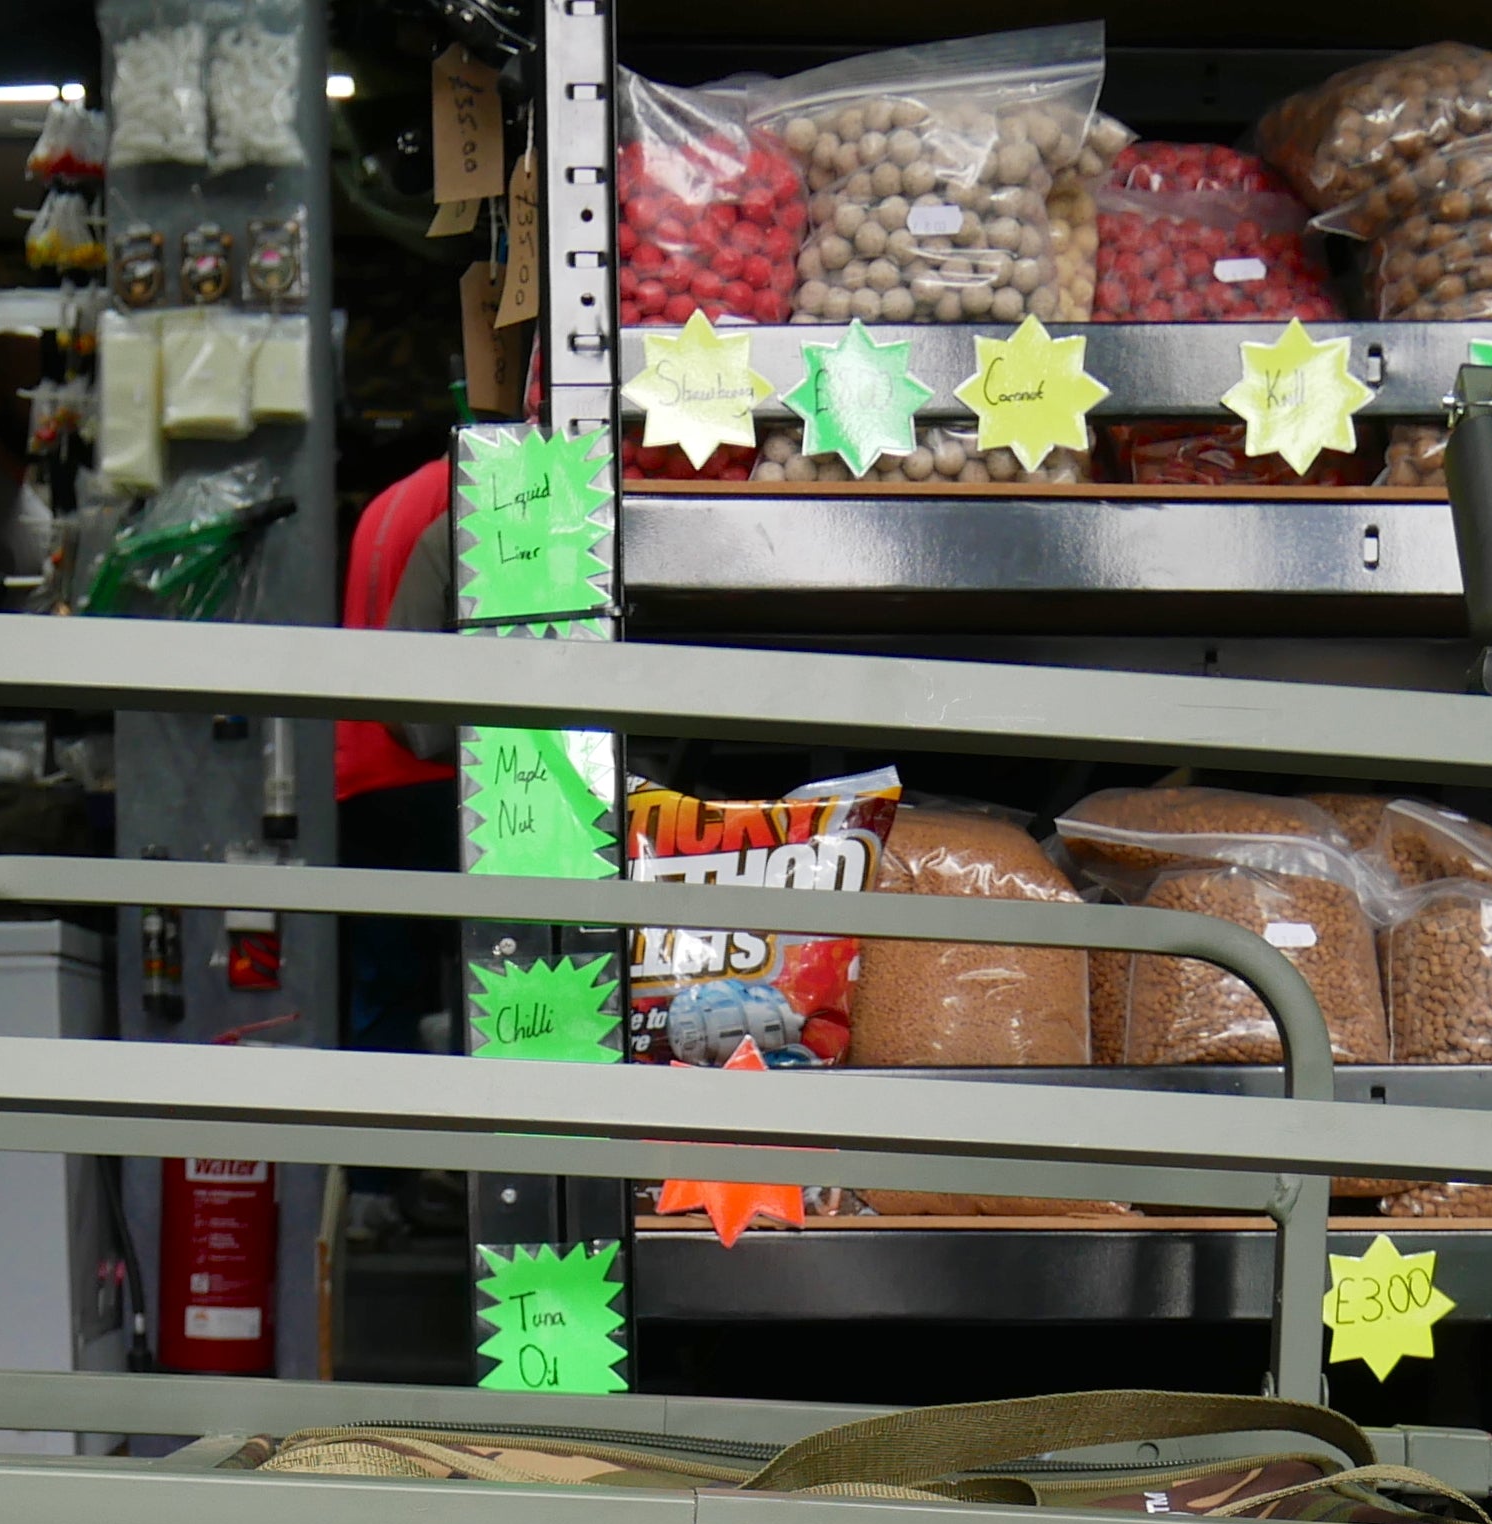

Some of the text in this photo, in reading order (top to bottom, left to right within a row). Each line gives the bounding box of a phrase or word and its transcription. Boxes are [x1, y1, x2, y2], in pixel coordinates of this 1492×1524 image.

[492, 472, 552, 519] Liquid
[494, 745, 548, 794] Maple
[498, 799, 536, 839] Nut
[627, 786, 830, 859] TICKY
[496, 1003, 554, 1044] Chilli
[509, 1291, 567, 1333] Tuna
[1335, 1267, 1433, 1325] £3.00
[519, 1344, 559, 1388] Oil
